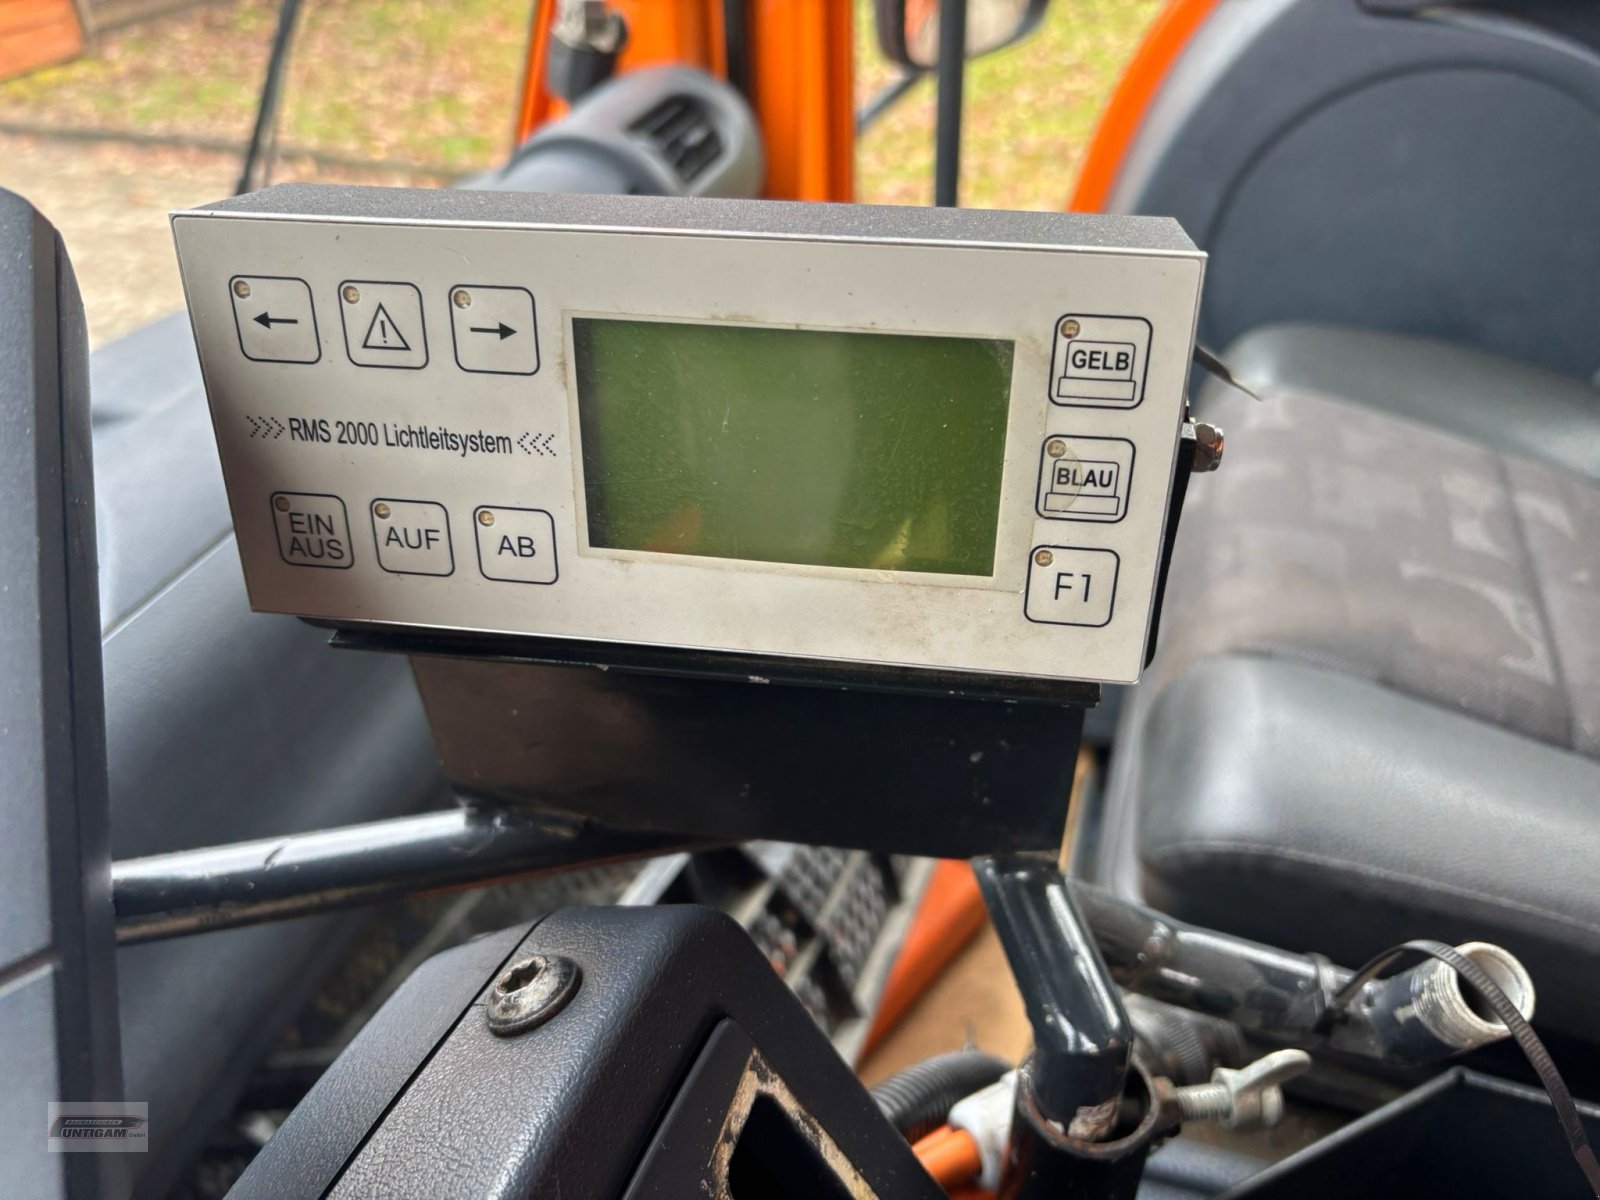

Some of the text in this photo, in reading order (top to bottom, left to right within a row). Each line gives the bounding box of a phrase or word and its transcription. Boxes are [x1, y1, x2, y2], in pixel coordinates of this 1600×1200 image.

[1071, 349, 1130, 371] GELB
[288, 418, 513, 457] RMS 2000 Lichtleitsystem
[1056, 467, 1113, 487] BLAU
[288, 512, 335, 536] EIN
[289, 537, 345, 560] AUS
[385, 526, 440, 550] AUF
[497, 535, 536, 558] AB
[1054, 572, 1092, 603] F1
